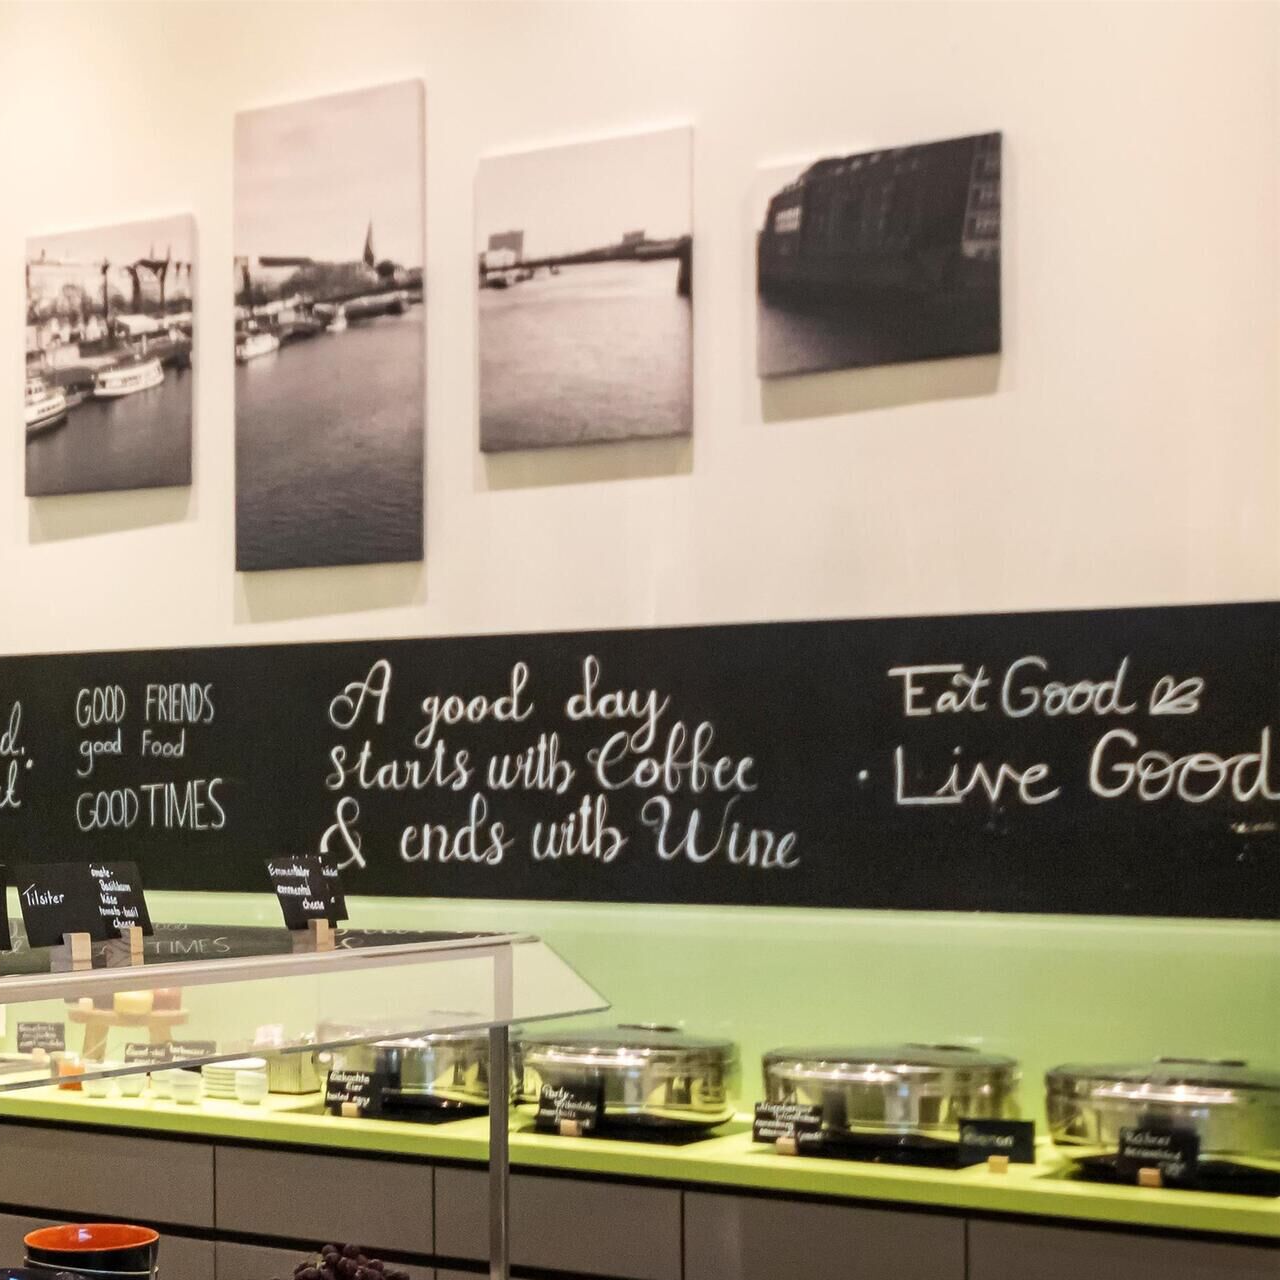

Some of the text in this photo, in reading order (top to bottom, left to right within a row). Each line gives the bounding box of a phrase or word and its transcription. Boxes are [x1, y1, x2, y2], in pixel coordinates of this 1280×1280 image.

[76, 682, 214, 728] GOOD FRIENDS
[329, 654, 670, 752] A good day
[887, 655, 1138, 718] Eat Good
[77, 727, 122, 777] good
[487, 731, 576, 794] with
[587, 721, 758, 794] Coffee
[895, 725, 1280, 806] Live Good
[76, 778, 225, 831] GOOD TIMES
[320, 792, 802, 871] & ends with Wine
[22, 883, 65, 906] Tilsiter
